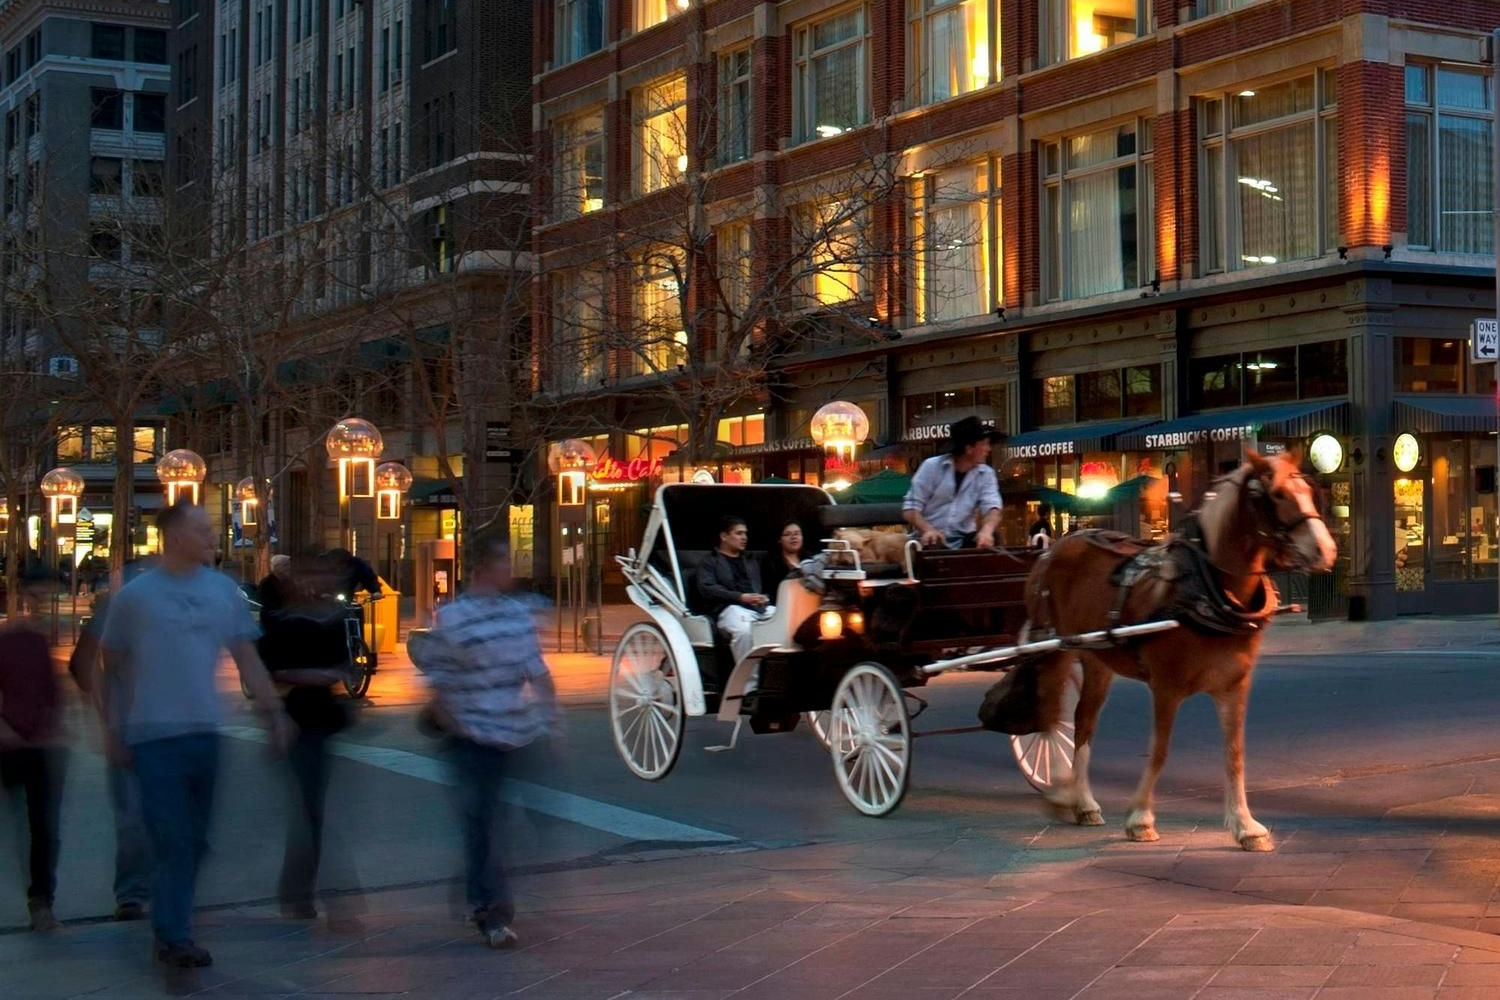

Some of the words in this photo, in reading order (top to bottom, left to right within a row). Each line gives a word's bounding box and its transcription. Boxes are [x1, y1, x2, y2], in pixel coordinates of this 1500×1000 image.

[1479, 322, 1497, 333] ONE
[1479, 333, 1497, 344] WAY
[902, 424, 951, 440] ARBUCKS
[1145, 430, 1208, 448] STARBUCKS
[1210, 425, 1252, 442] COFFEE
[1007, 445, 1037, 459] BUCKS
[1038, 441, 1074, 455] COFFEE
